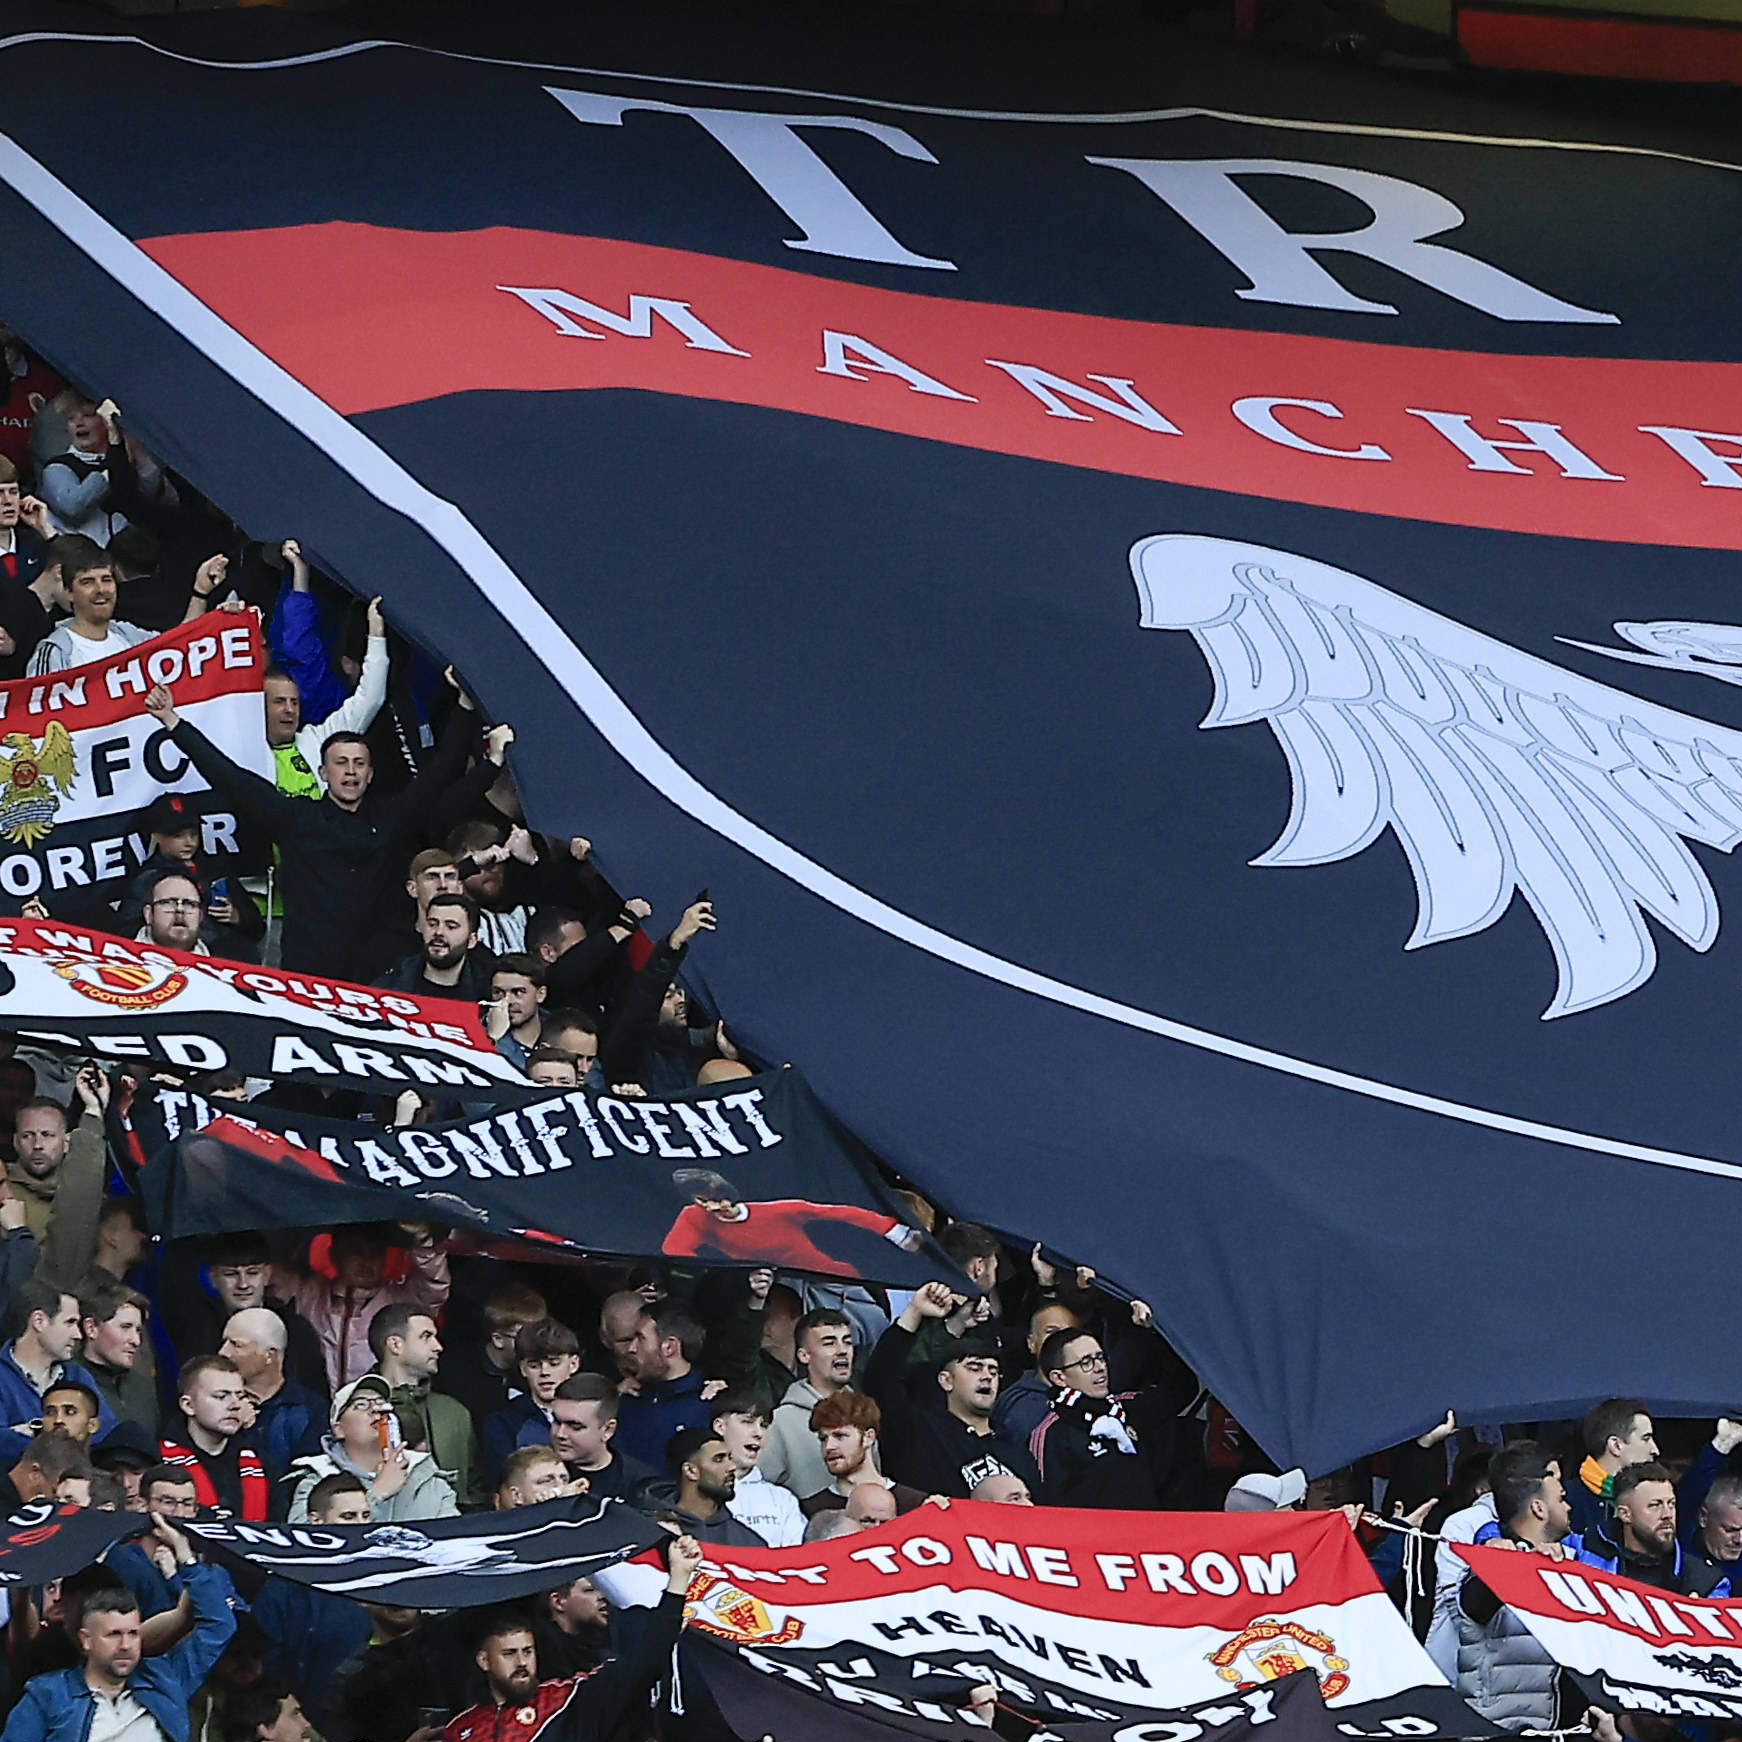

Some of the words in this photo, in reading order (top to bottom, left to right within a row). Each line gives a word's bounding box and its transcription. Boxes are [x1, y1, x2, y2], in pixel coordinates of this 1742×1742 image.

[27, 677, 86, 715] IN
[105, 627, 254, 698] HOPE
[0, 811, 241, 898] OREVR
[79, 980, 150, 1010] FOOTBALL
[197, 964, 420, 1017] YOURS
[16, 1030, 224, 1072] ED
[268, 1034, 492, 1090] ARM
[850, 1535, 953, 1577] TO
[965, 1535, 1080, 1588] ME
[1095, 1551, 1297, 1597] FROM
[872, 1611, 1153, 1690] HEAVEN
